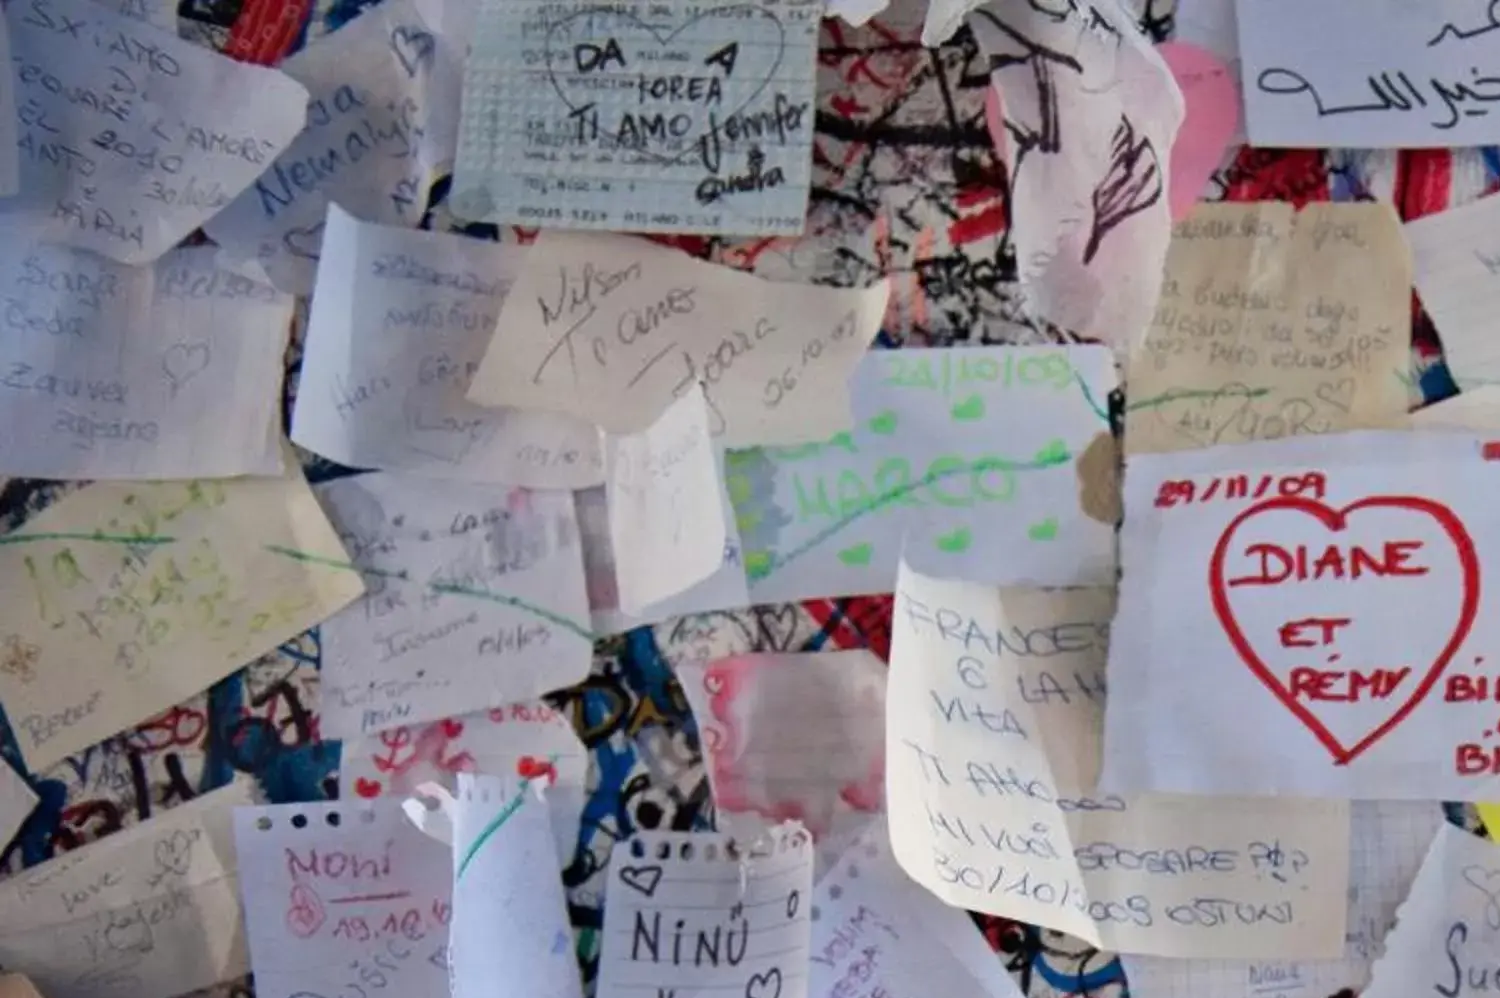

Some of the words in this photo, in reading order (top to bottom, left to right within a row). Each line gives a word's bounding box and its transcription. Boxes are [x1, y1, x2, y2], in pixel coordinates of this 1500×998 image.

[617, 112, 693, 140] AMO
[1229, 541, 1430, 587] DIANE
[1279, 618, 1352, 647] ET
